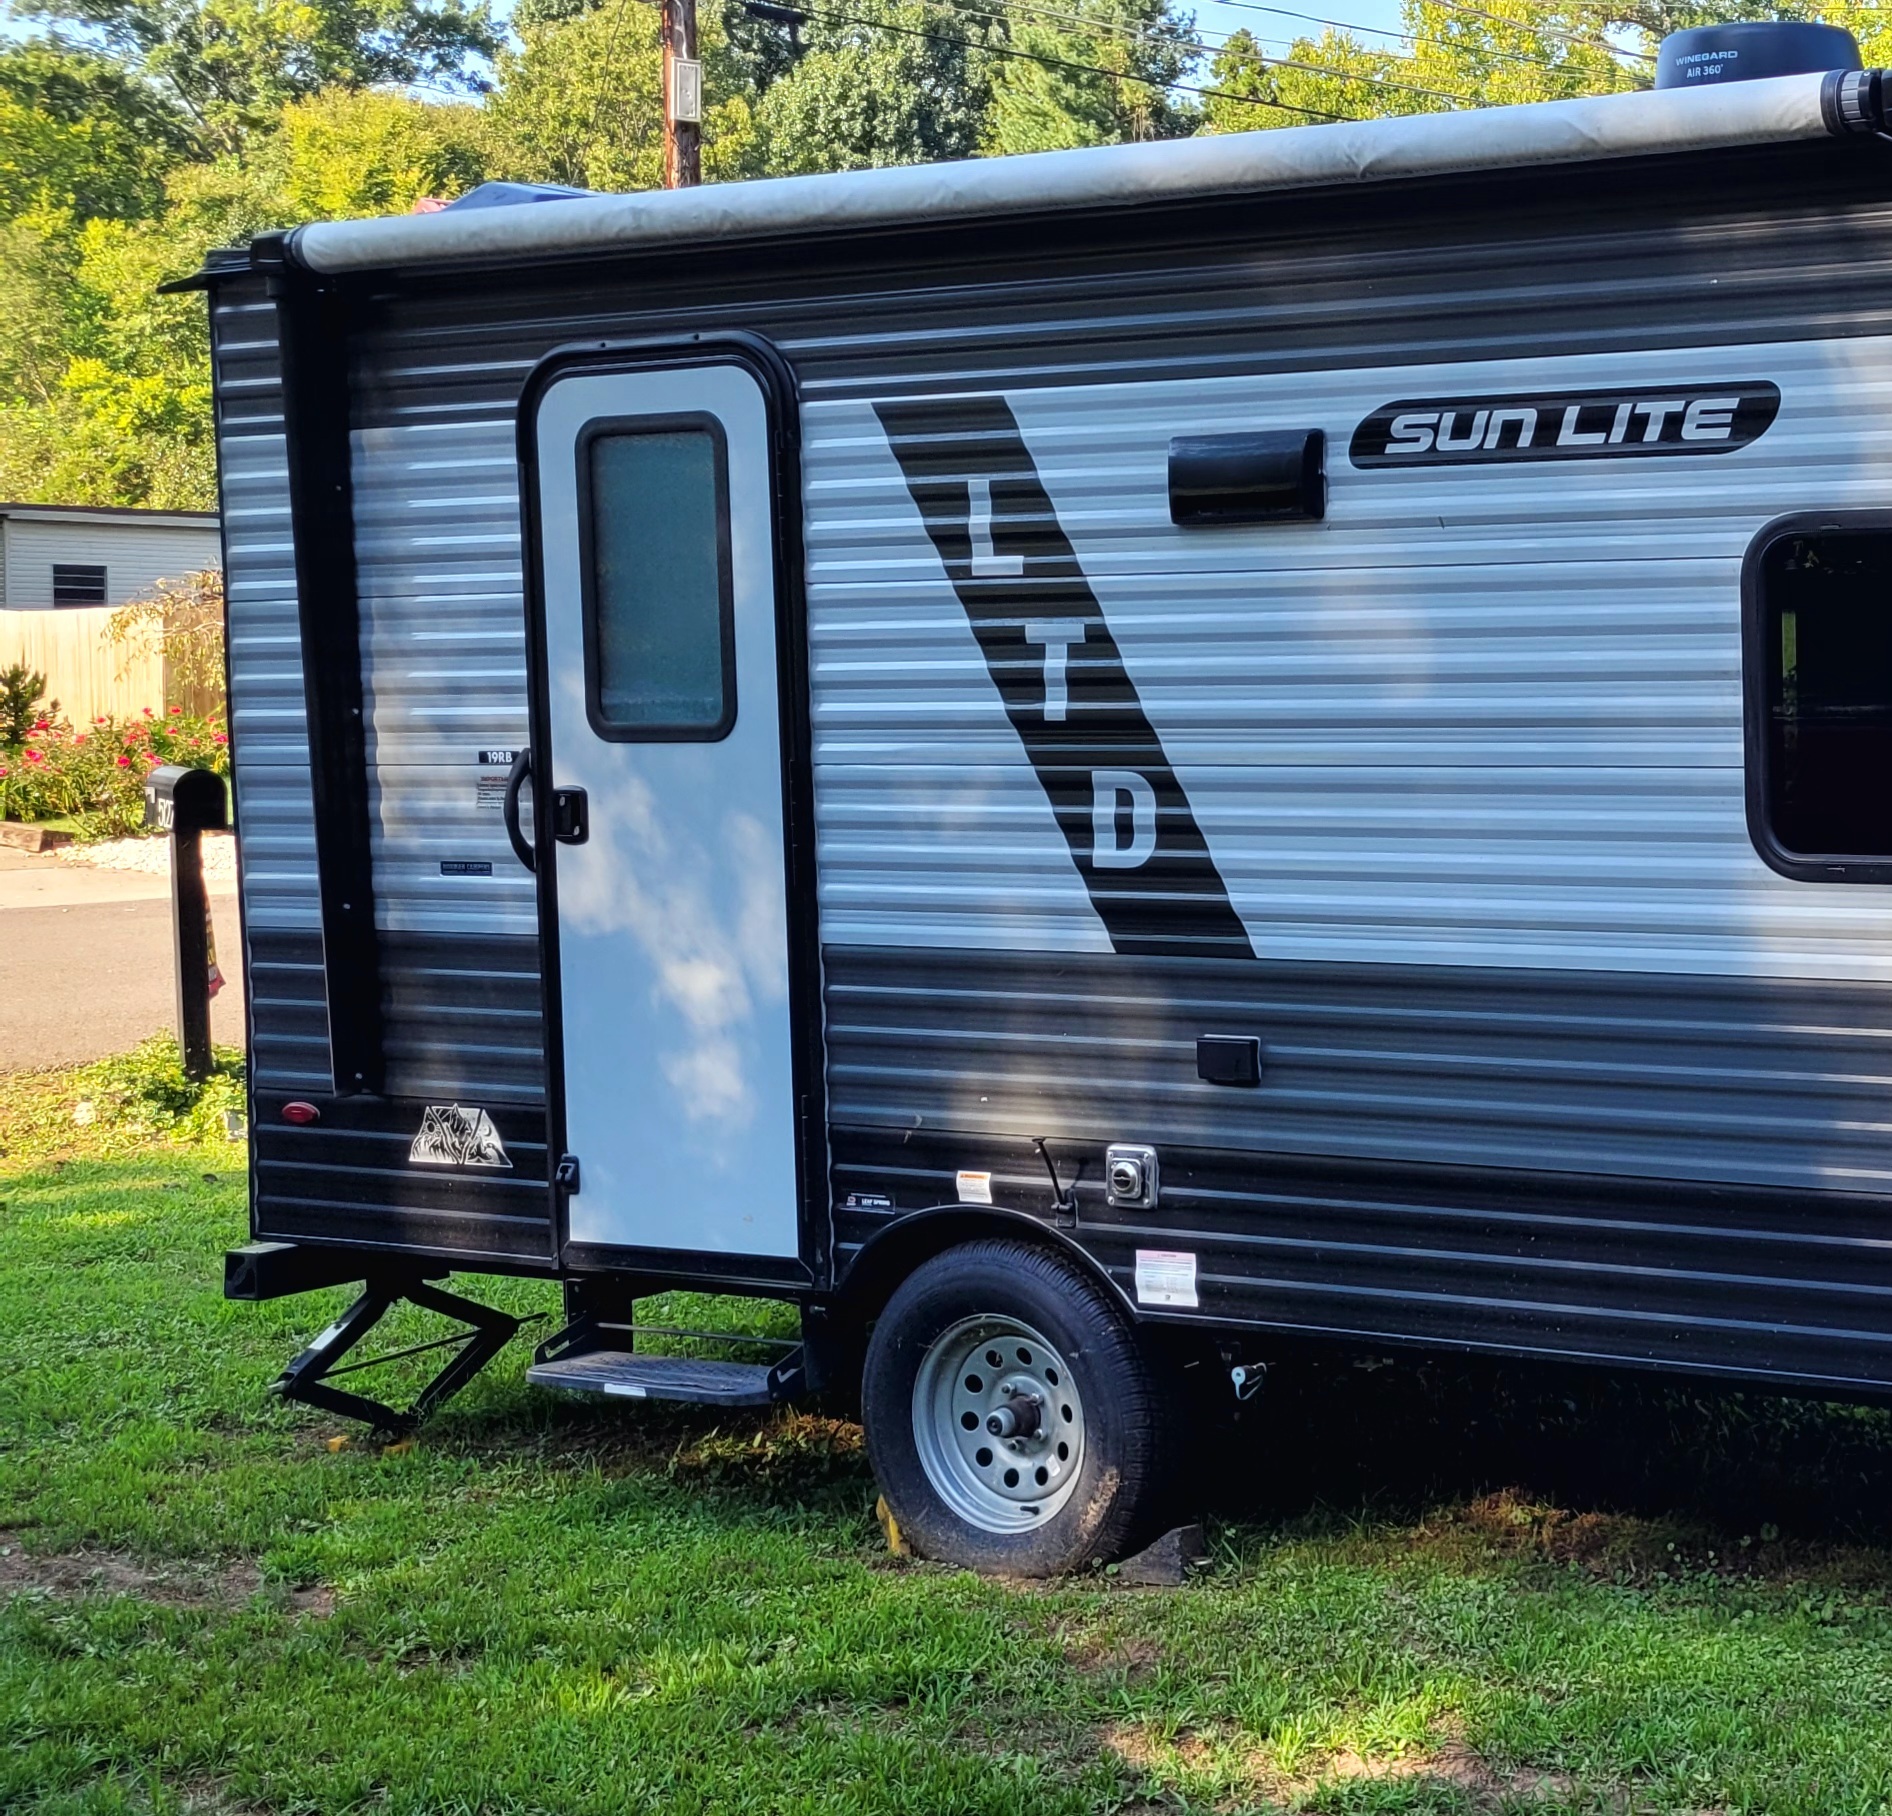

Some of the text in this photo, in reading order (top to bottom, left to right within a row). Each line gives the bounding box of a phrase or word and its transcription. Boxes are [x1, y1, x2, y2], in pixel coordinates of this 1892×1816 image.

[1675, 50, 1739, 66] WINEGARD
[1686, 67, 1702, 79] AIR
[1383, 397, 1741, 455] SUN LITE
[486, 751, 513, 764] 19RB
